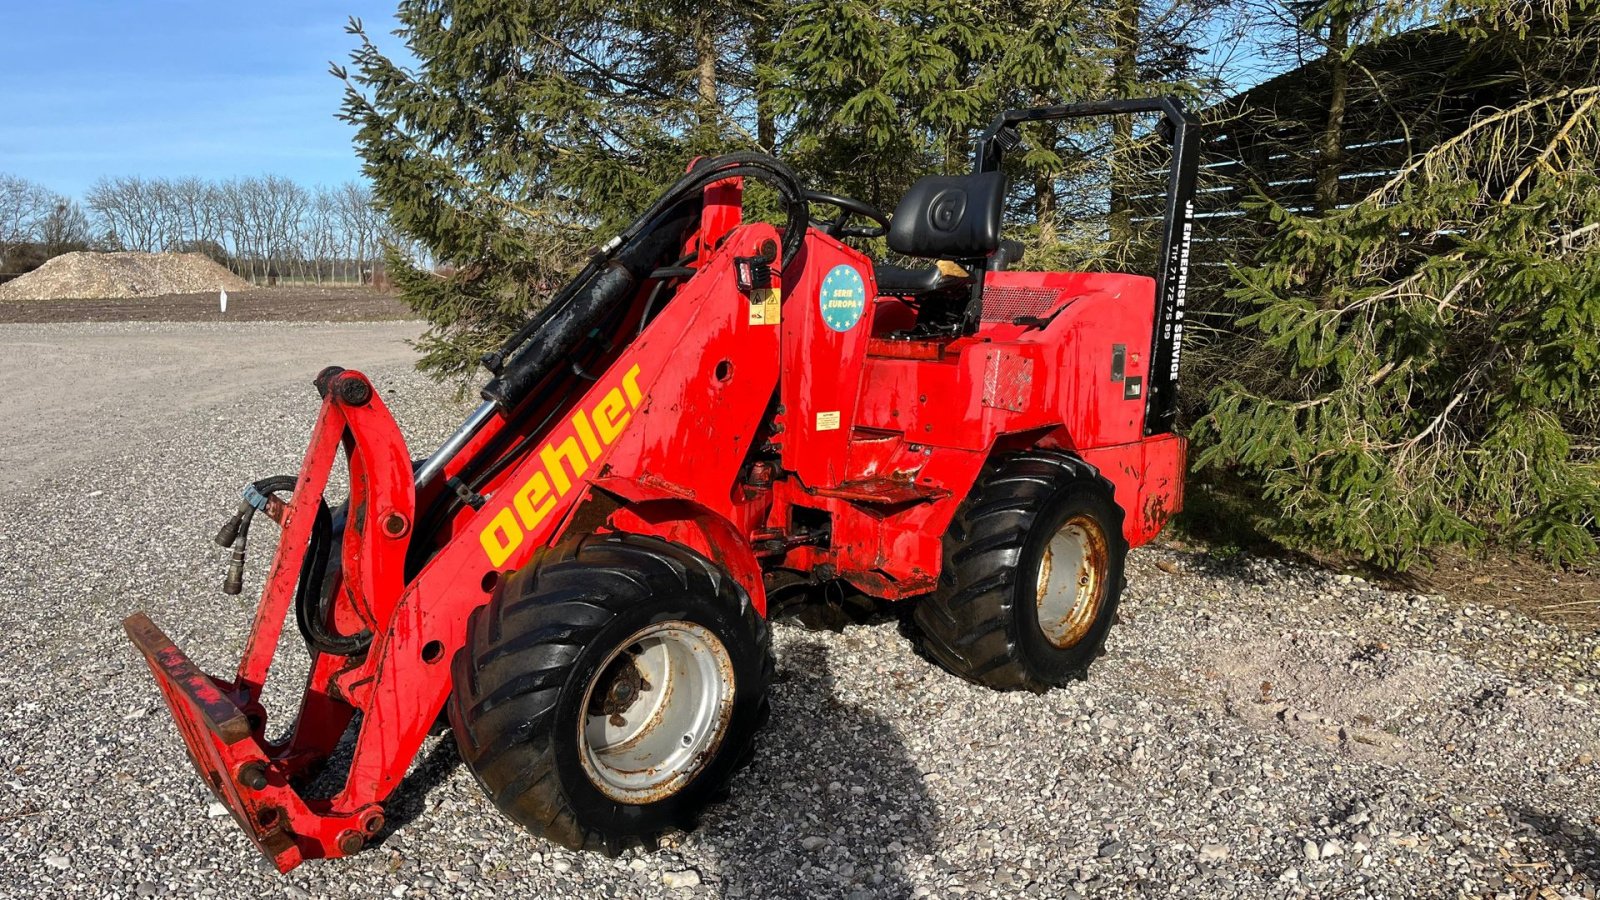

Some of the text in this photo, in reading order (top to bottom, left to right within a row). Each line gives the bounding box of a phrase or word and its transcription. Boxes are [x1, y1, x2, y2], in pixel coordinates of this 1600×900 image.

[1170, 266, 1177, 281] 71
[833, 289, 853, 297] SERIE
[1167, 285, 1175, 301] 72
[1170, 200, 1193, 381] JH ENTREPRISE & SERVICE
[828, 300, 857, 308] EUROPA
[1165, 305, 1173, 320] 75
[1163, 323, 1171, 340] 89
[480, 363, 643, 568] oehler
